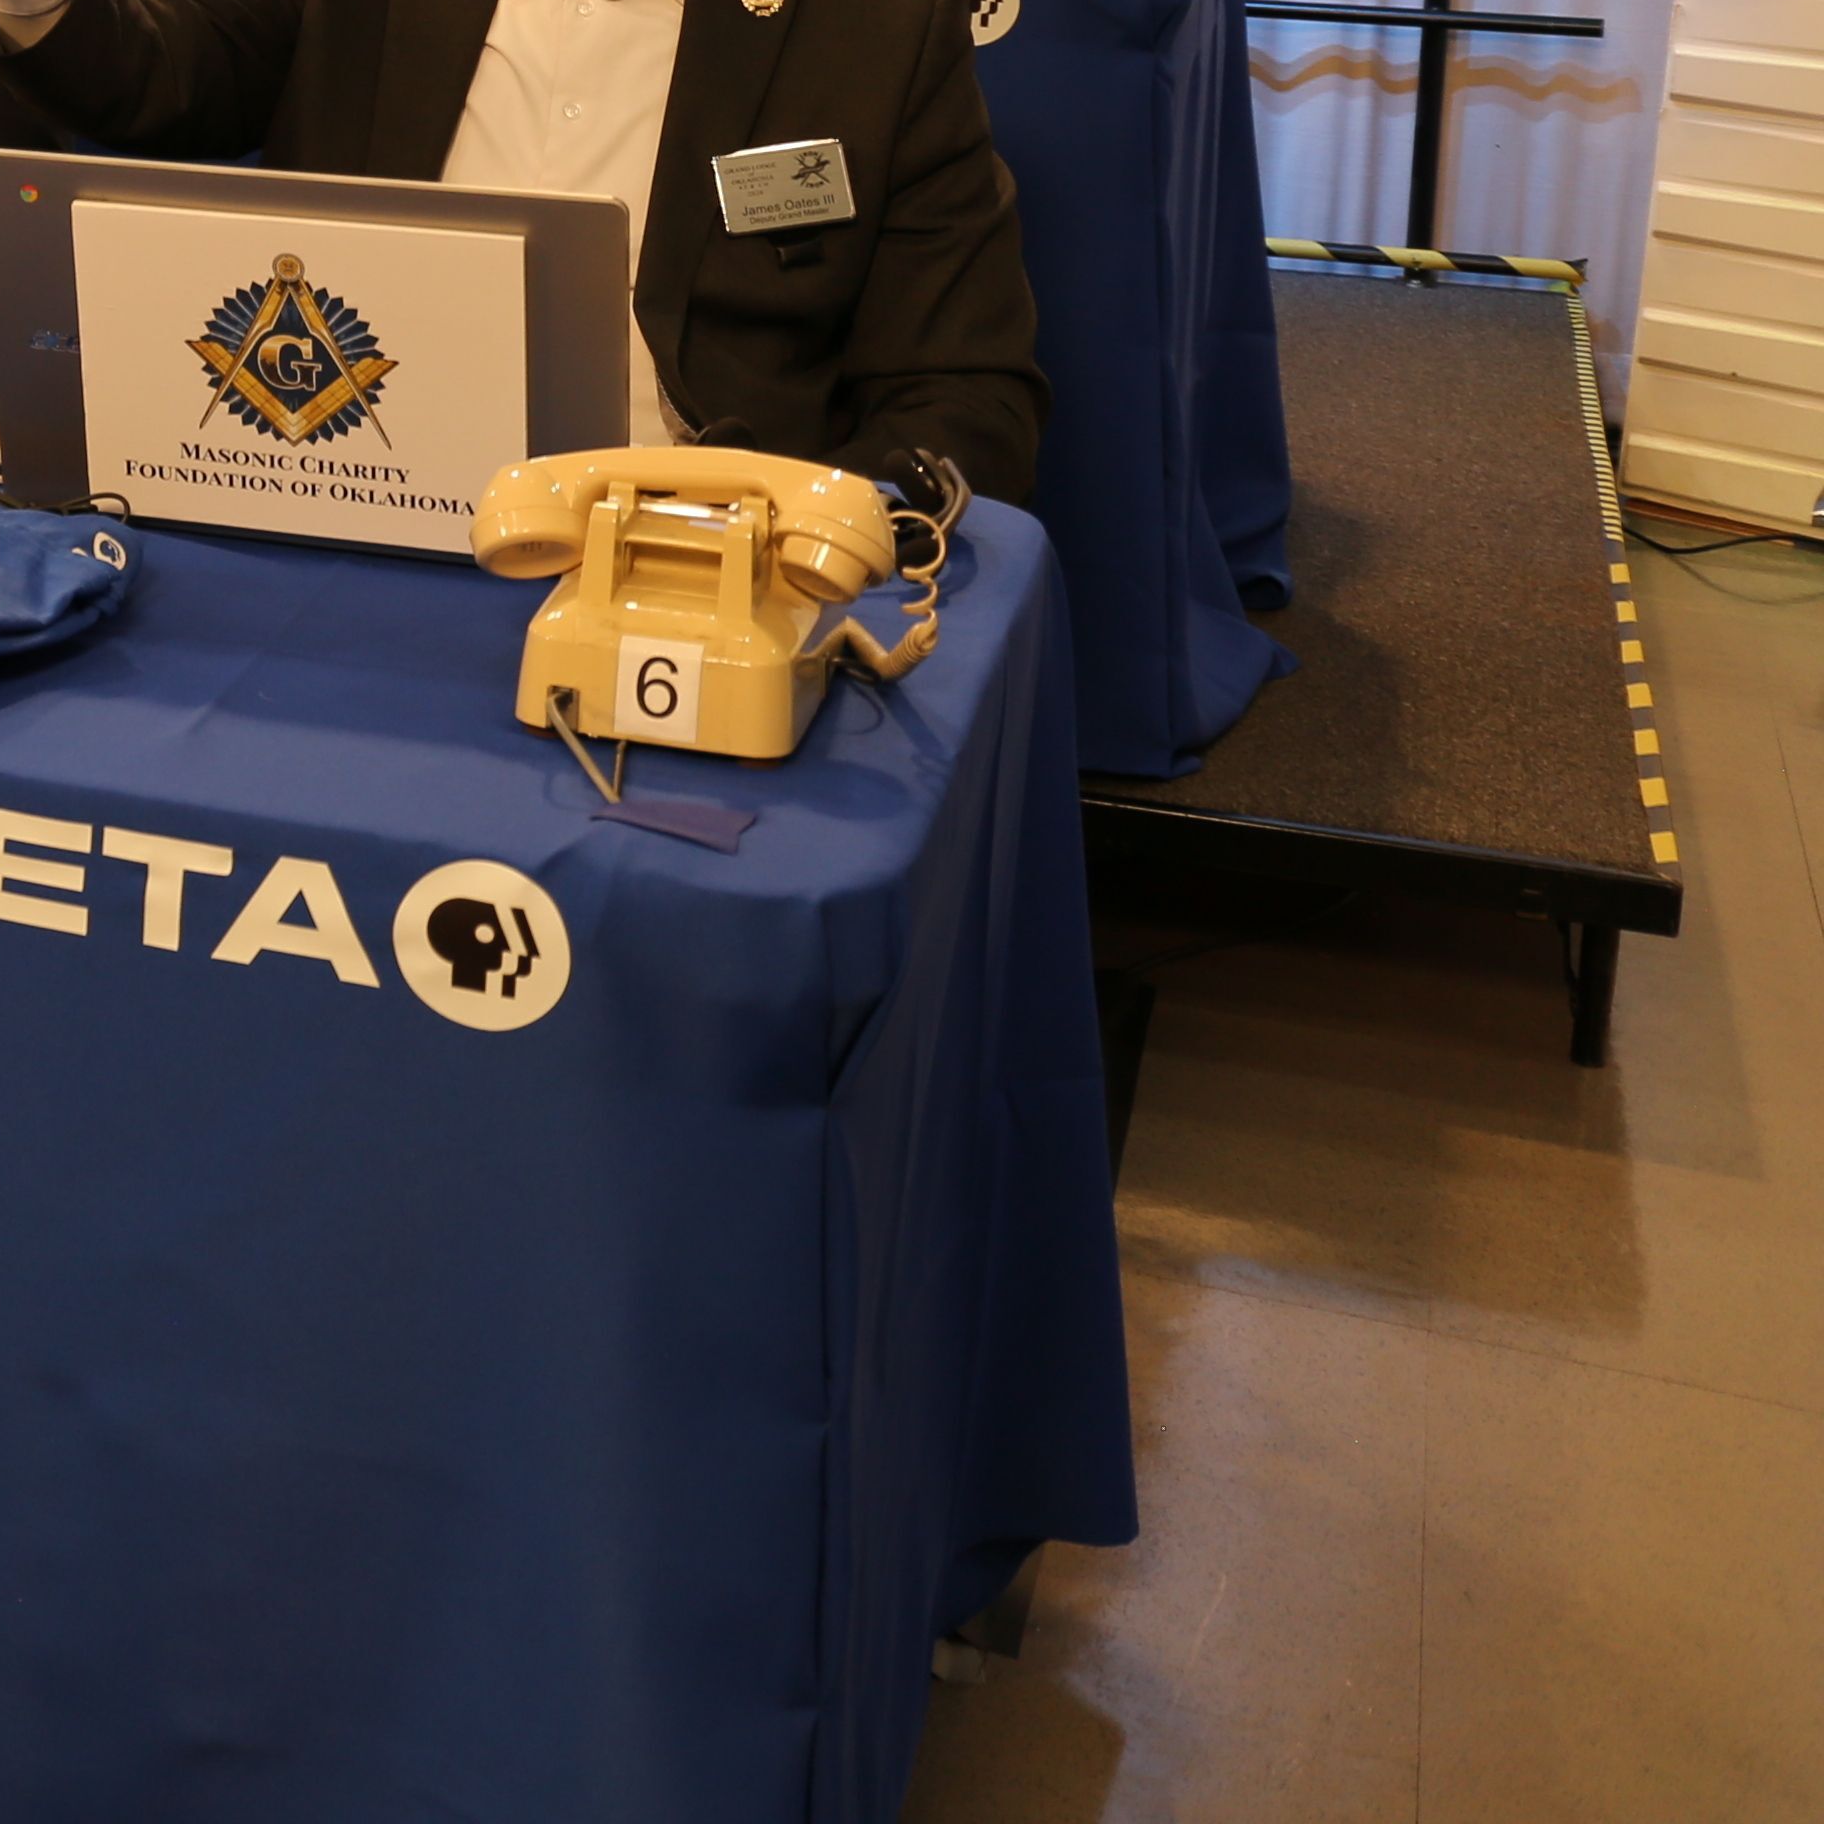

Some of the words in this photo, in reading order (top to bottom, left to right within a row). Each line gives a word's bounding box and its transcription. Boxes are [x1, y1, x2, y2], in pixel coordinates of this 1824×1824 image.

[742, 202, 781, 217] James
[784, 198, 820, 211] Oates
[823, 194, 836, 205] III
[124, 458, 284, 495] FOUNDATION
[290, 479, 324, 498] OF
[328, 482, 475, 517] OKLAHOMA
[179, 441, 293, 472] MASONIC
[298, 454, 410, 485] CHARITY
[636, 656, 678, 718] 6
